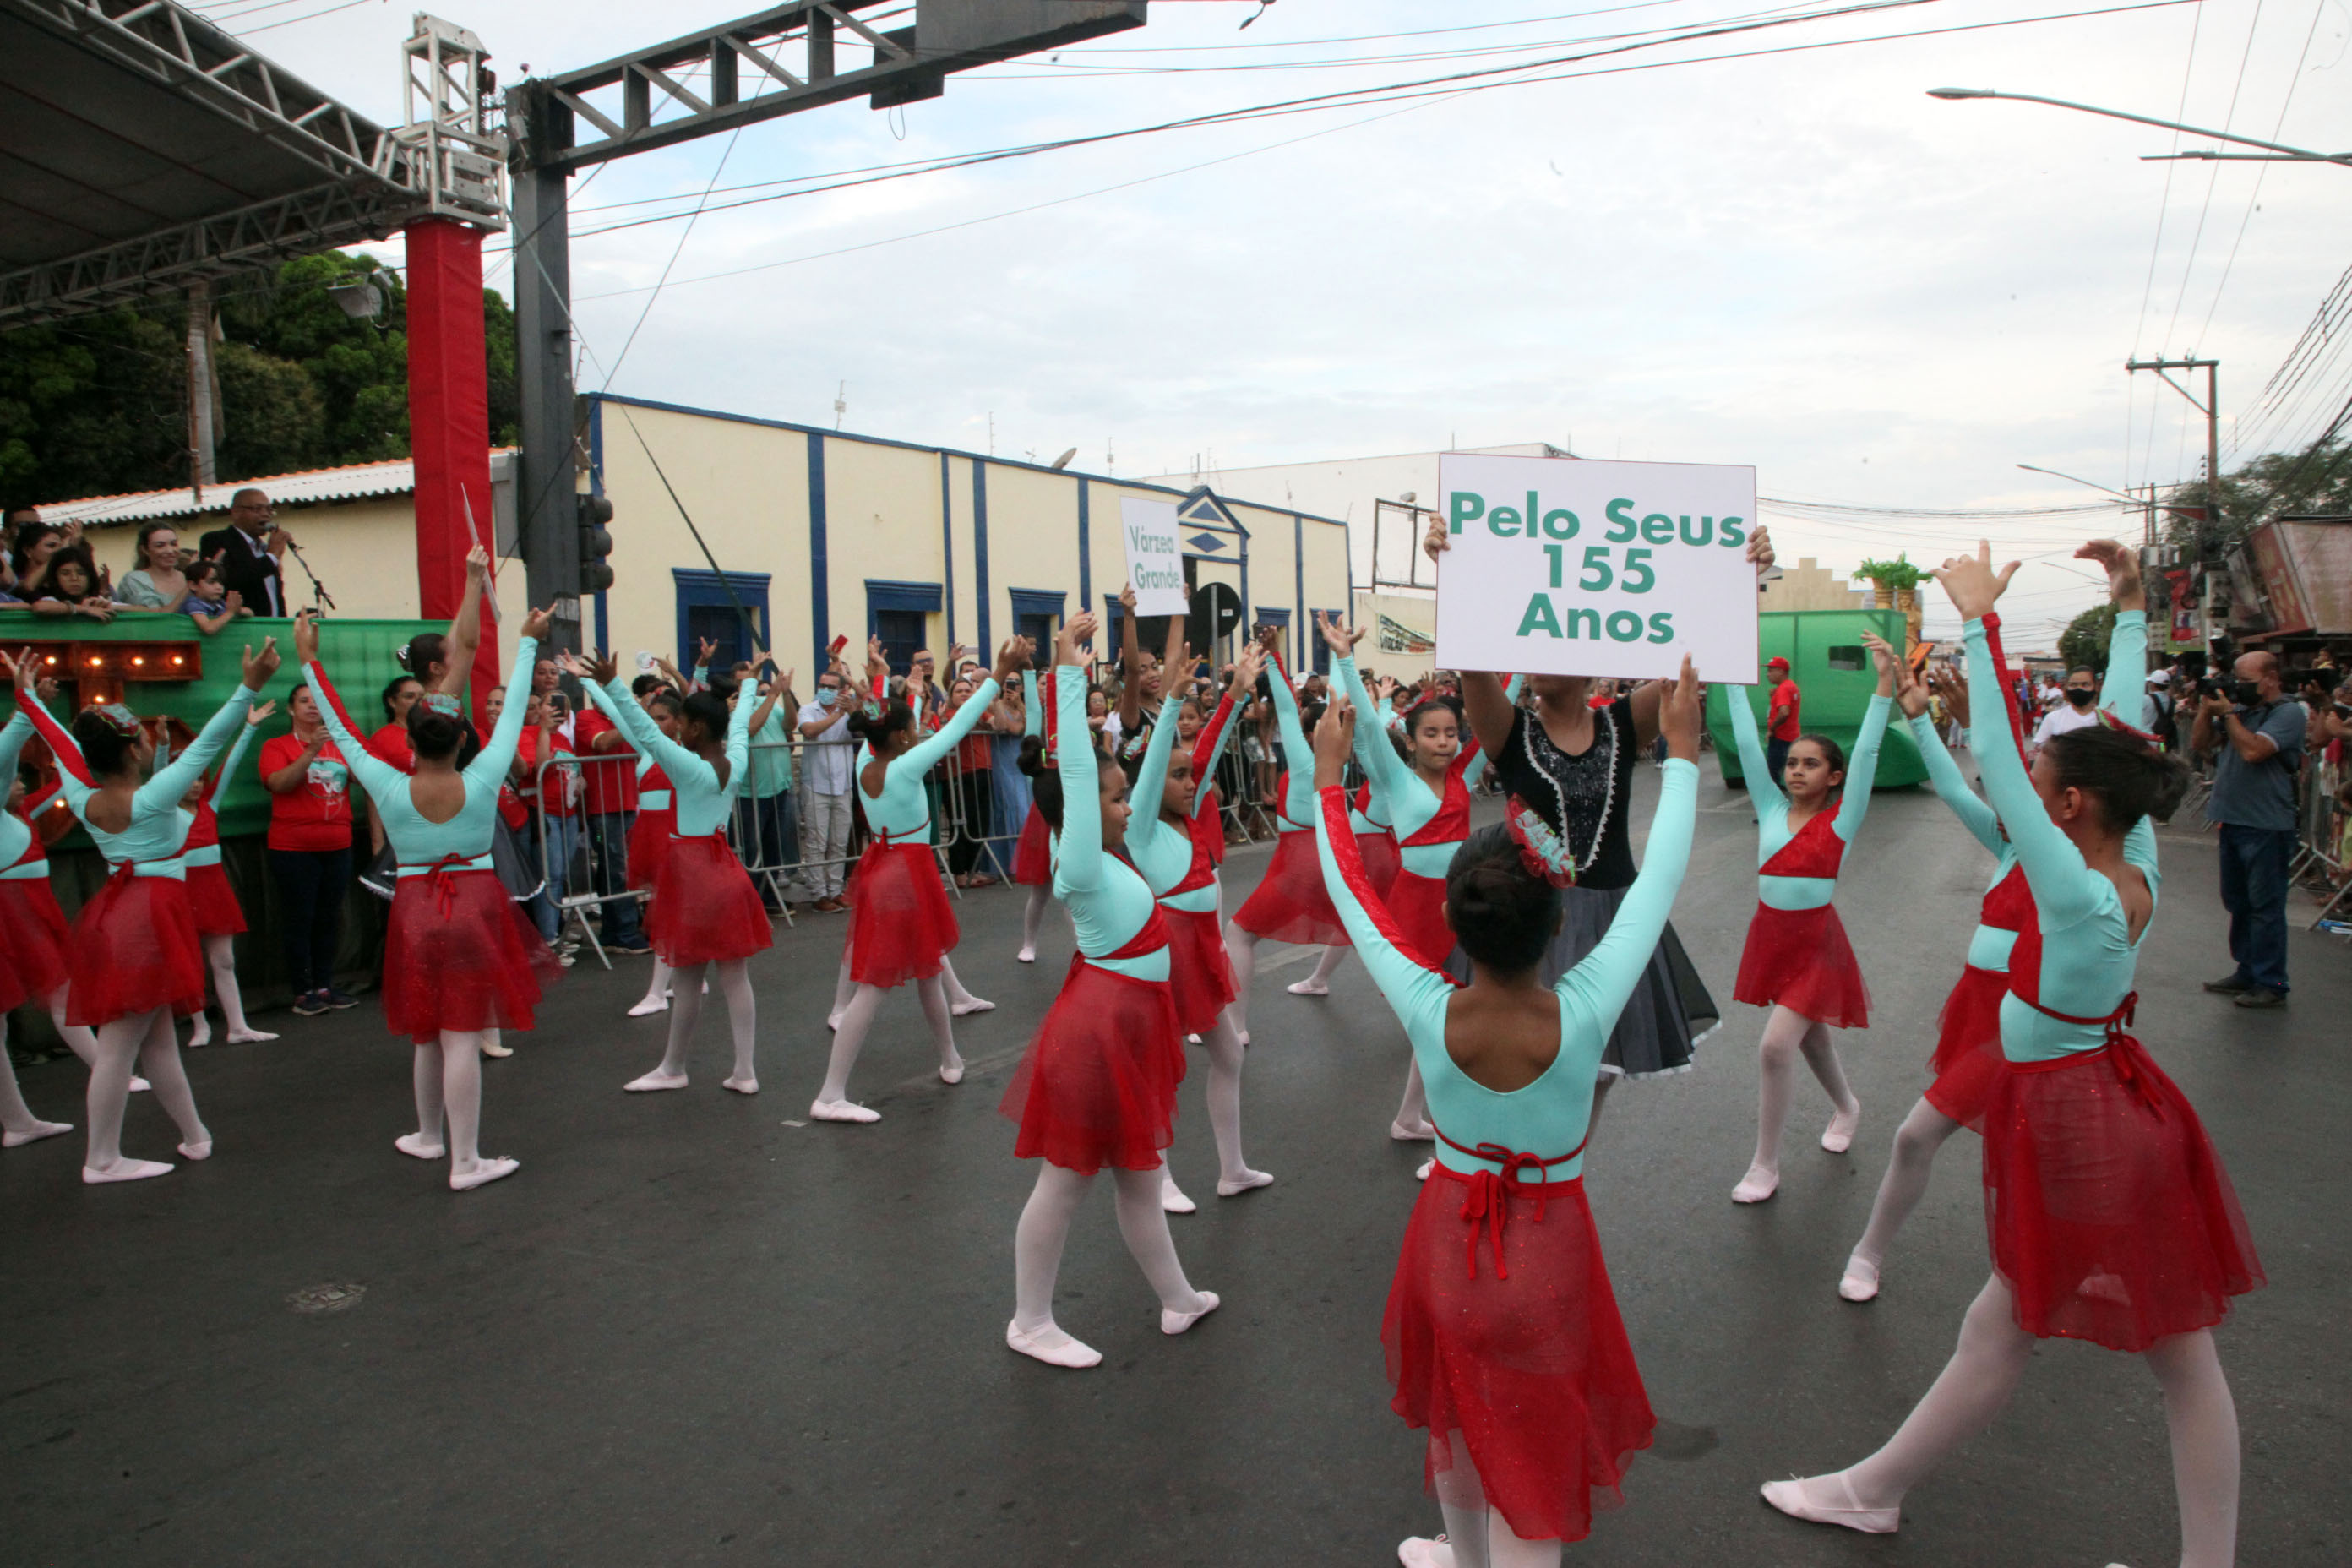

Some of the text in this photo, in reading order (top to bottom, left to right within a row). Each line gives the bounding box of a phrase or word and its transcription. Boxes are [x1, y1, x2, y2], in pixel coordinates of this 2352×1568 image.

[1129, 525, 1175, 554] Várzea
[1450, 491, 1746, 548] Pelo Seus
[1135, 561, 1180, 590] Grande
[1544, 543, 1656, 594] 155
[1516, 592, 1675, 645] Anos
